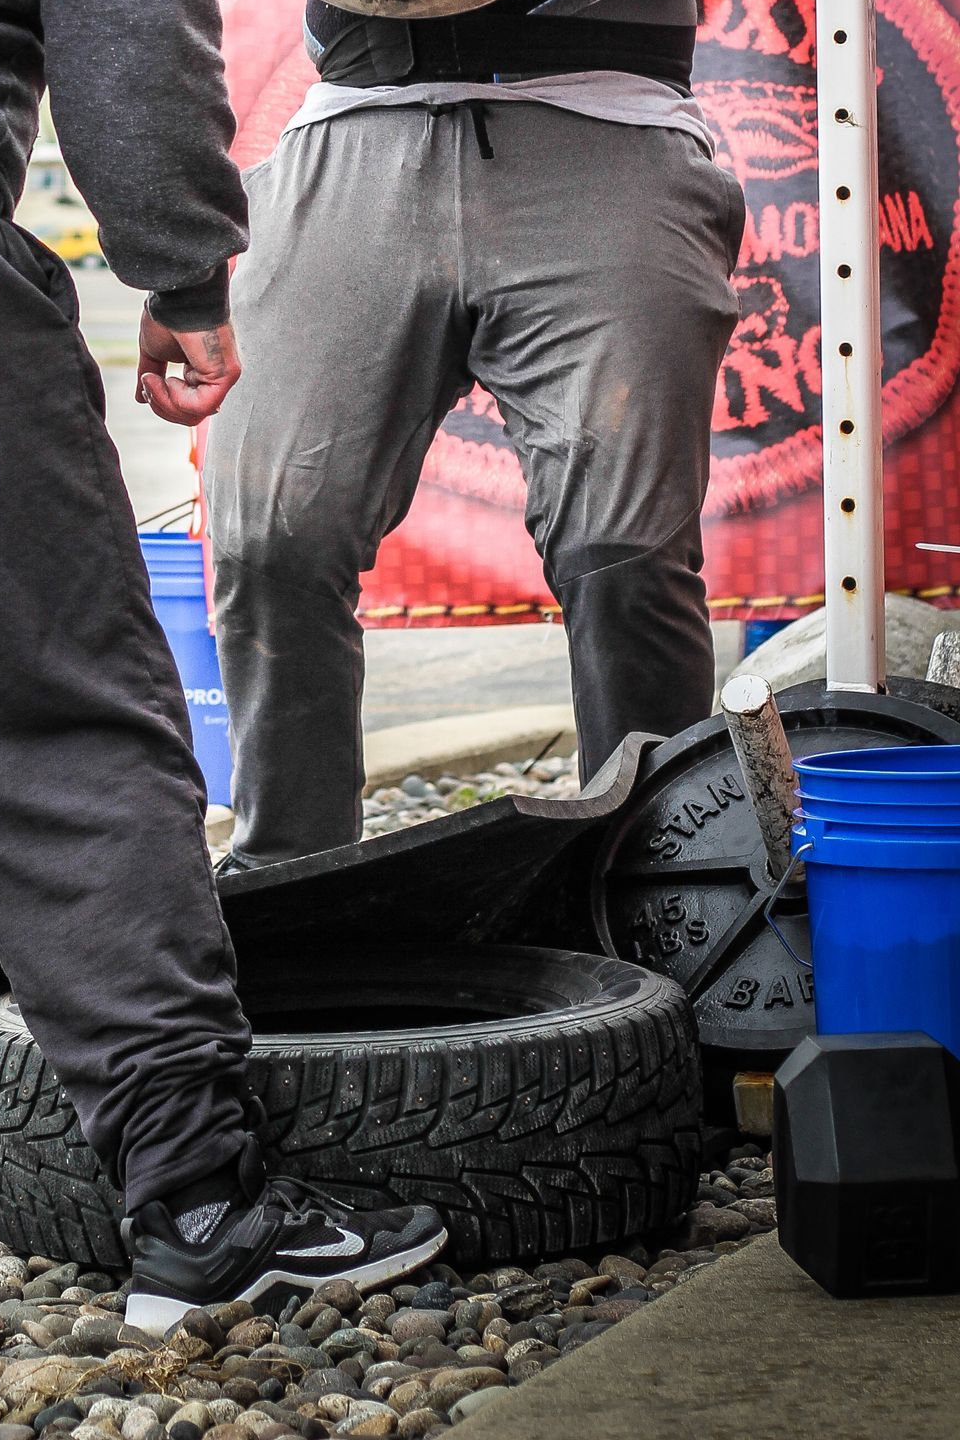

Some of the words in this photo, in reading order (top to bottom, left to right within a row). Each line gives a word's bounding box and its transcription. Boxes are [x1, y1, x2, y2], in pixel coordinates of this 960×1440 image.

[737, 190, 934, 266] MOANA
[649, 773, 746, 860] STAN
[634, 894, 688, 929] 45
